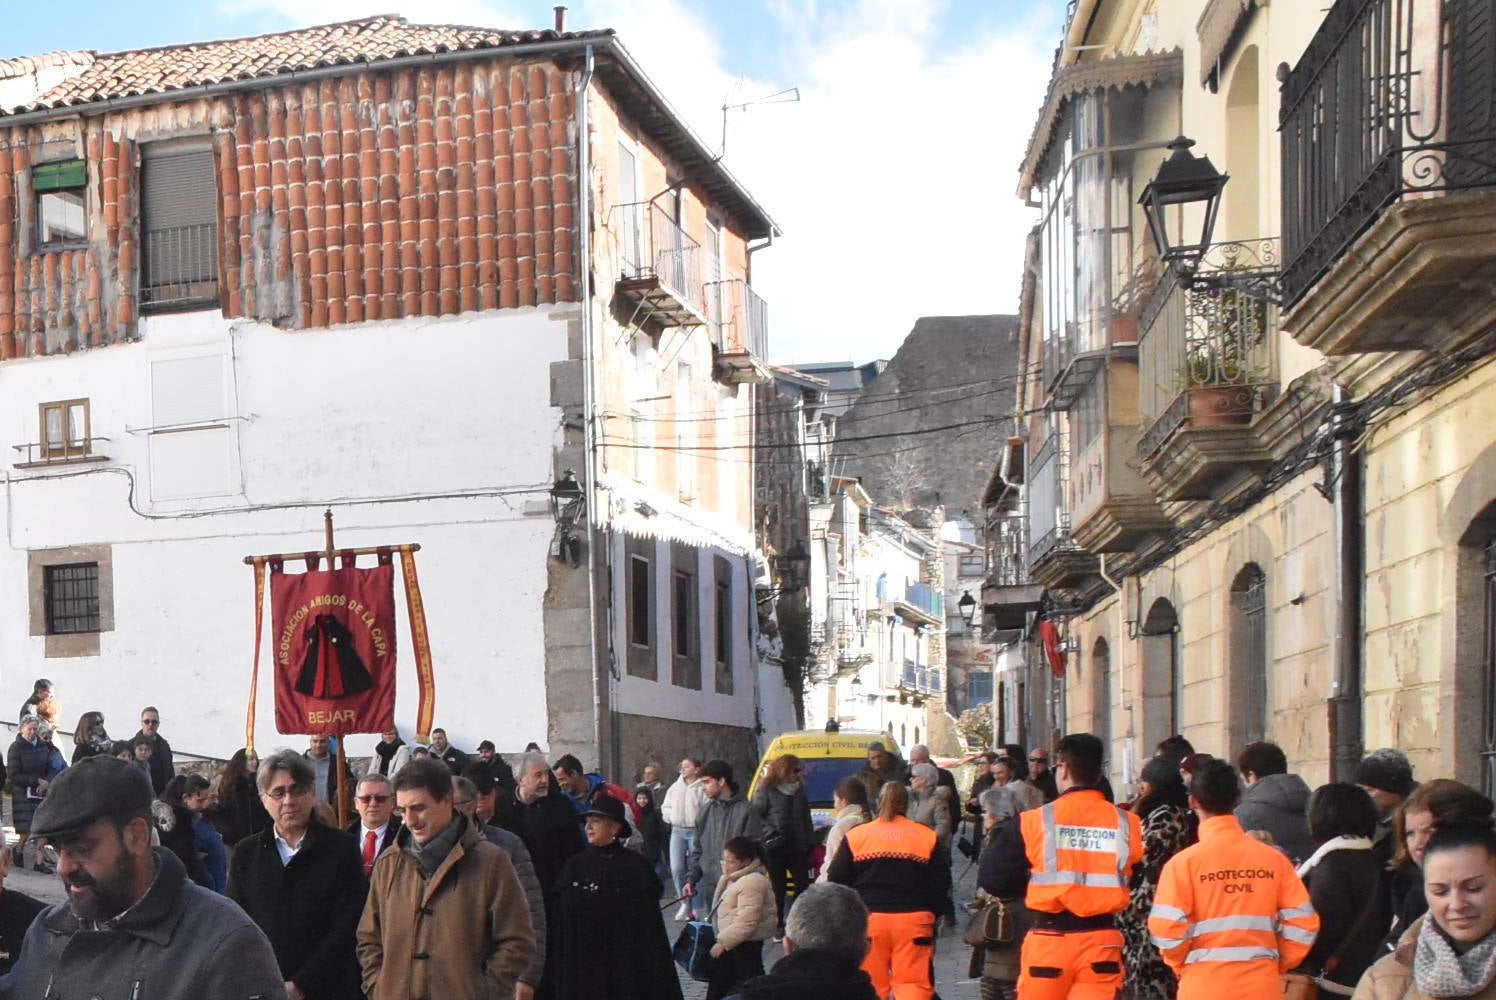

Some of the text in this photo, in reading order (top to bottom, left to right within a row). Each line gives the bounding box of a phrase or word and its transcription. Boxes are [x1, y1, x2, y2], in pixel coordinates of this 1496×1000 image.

[279, 594, 387, 665] ASOCIACION AMIGOS DE LA CAPA
[308, 710, 354, 724] BEJAR
[1060, 828, 1116, 840] PROTECCION
[1070, 838, 1101, 848] CIVIL
[1200, 869, 1274, 884] PROTECCION
[1224, 884, 1254, 894] CIVIL
